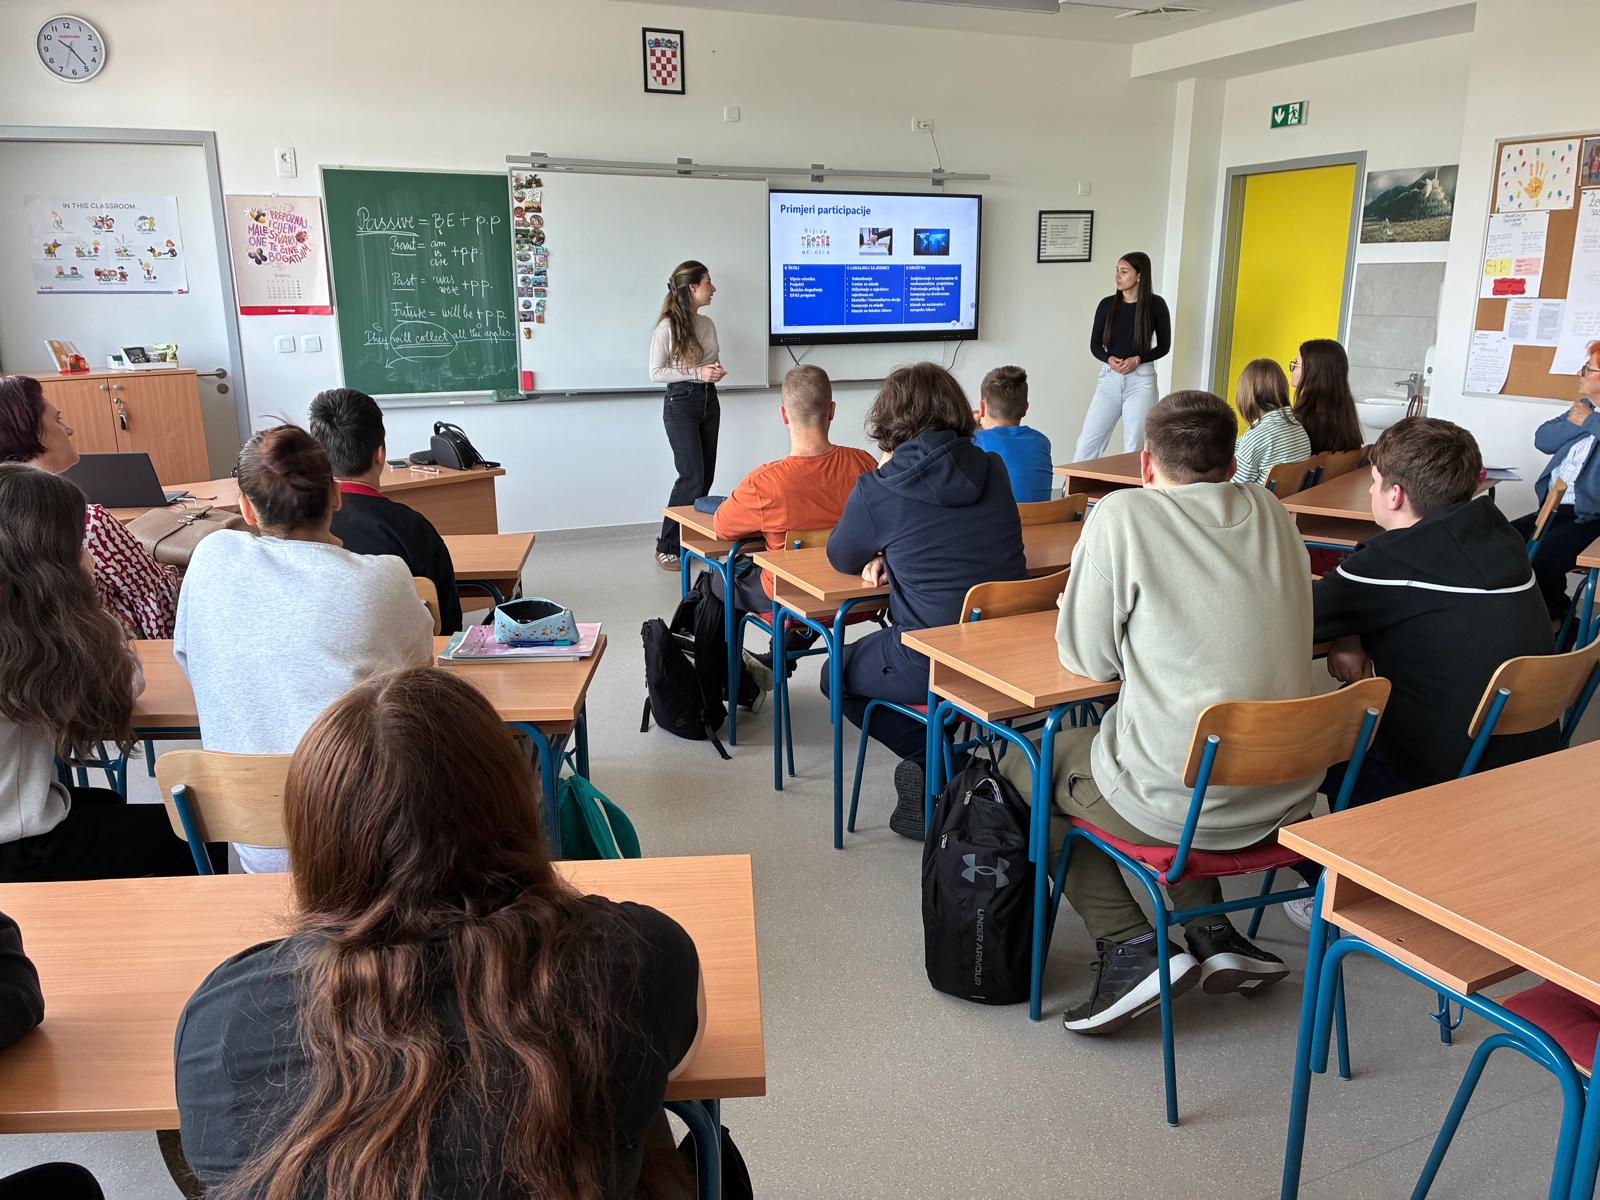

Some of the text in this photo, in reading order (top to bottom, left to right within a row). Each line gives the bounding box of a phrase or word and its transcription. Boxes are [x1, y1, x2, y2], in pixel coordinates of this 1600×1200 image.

[270, 209, 308, 230] PREPOZNAJ
[357, 206, 415, 231] Passive
[431, 212, 456, 229] BE
[780, 203, 872, 217] Primjeri participacije
[248, 222, 268, 236] MALE
[272, 221, 297, 234] CIJENI
[248, 236, 268, 248] ONE
[268, 242, 278, 252] TE
[268, 244, 312, 265] BOGATIJIM
[391, 271, 417, 287] Past
[390, 301, 428, 320] Future
[441, 303, 461, 319] will
[462, 302, 474, 319] be
[364, 329, 390, 350] They
[415, 329, 450, 344] collect
[452, 328, 467, 340] all
[974, 907, 985, 986] UNDER ARMOUR
